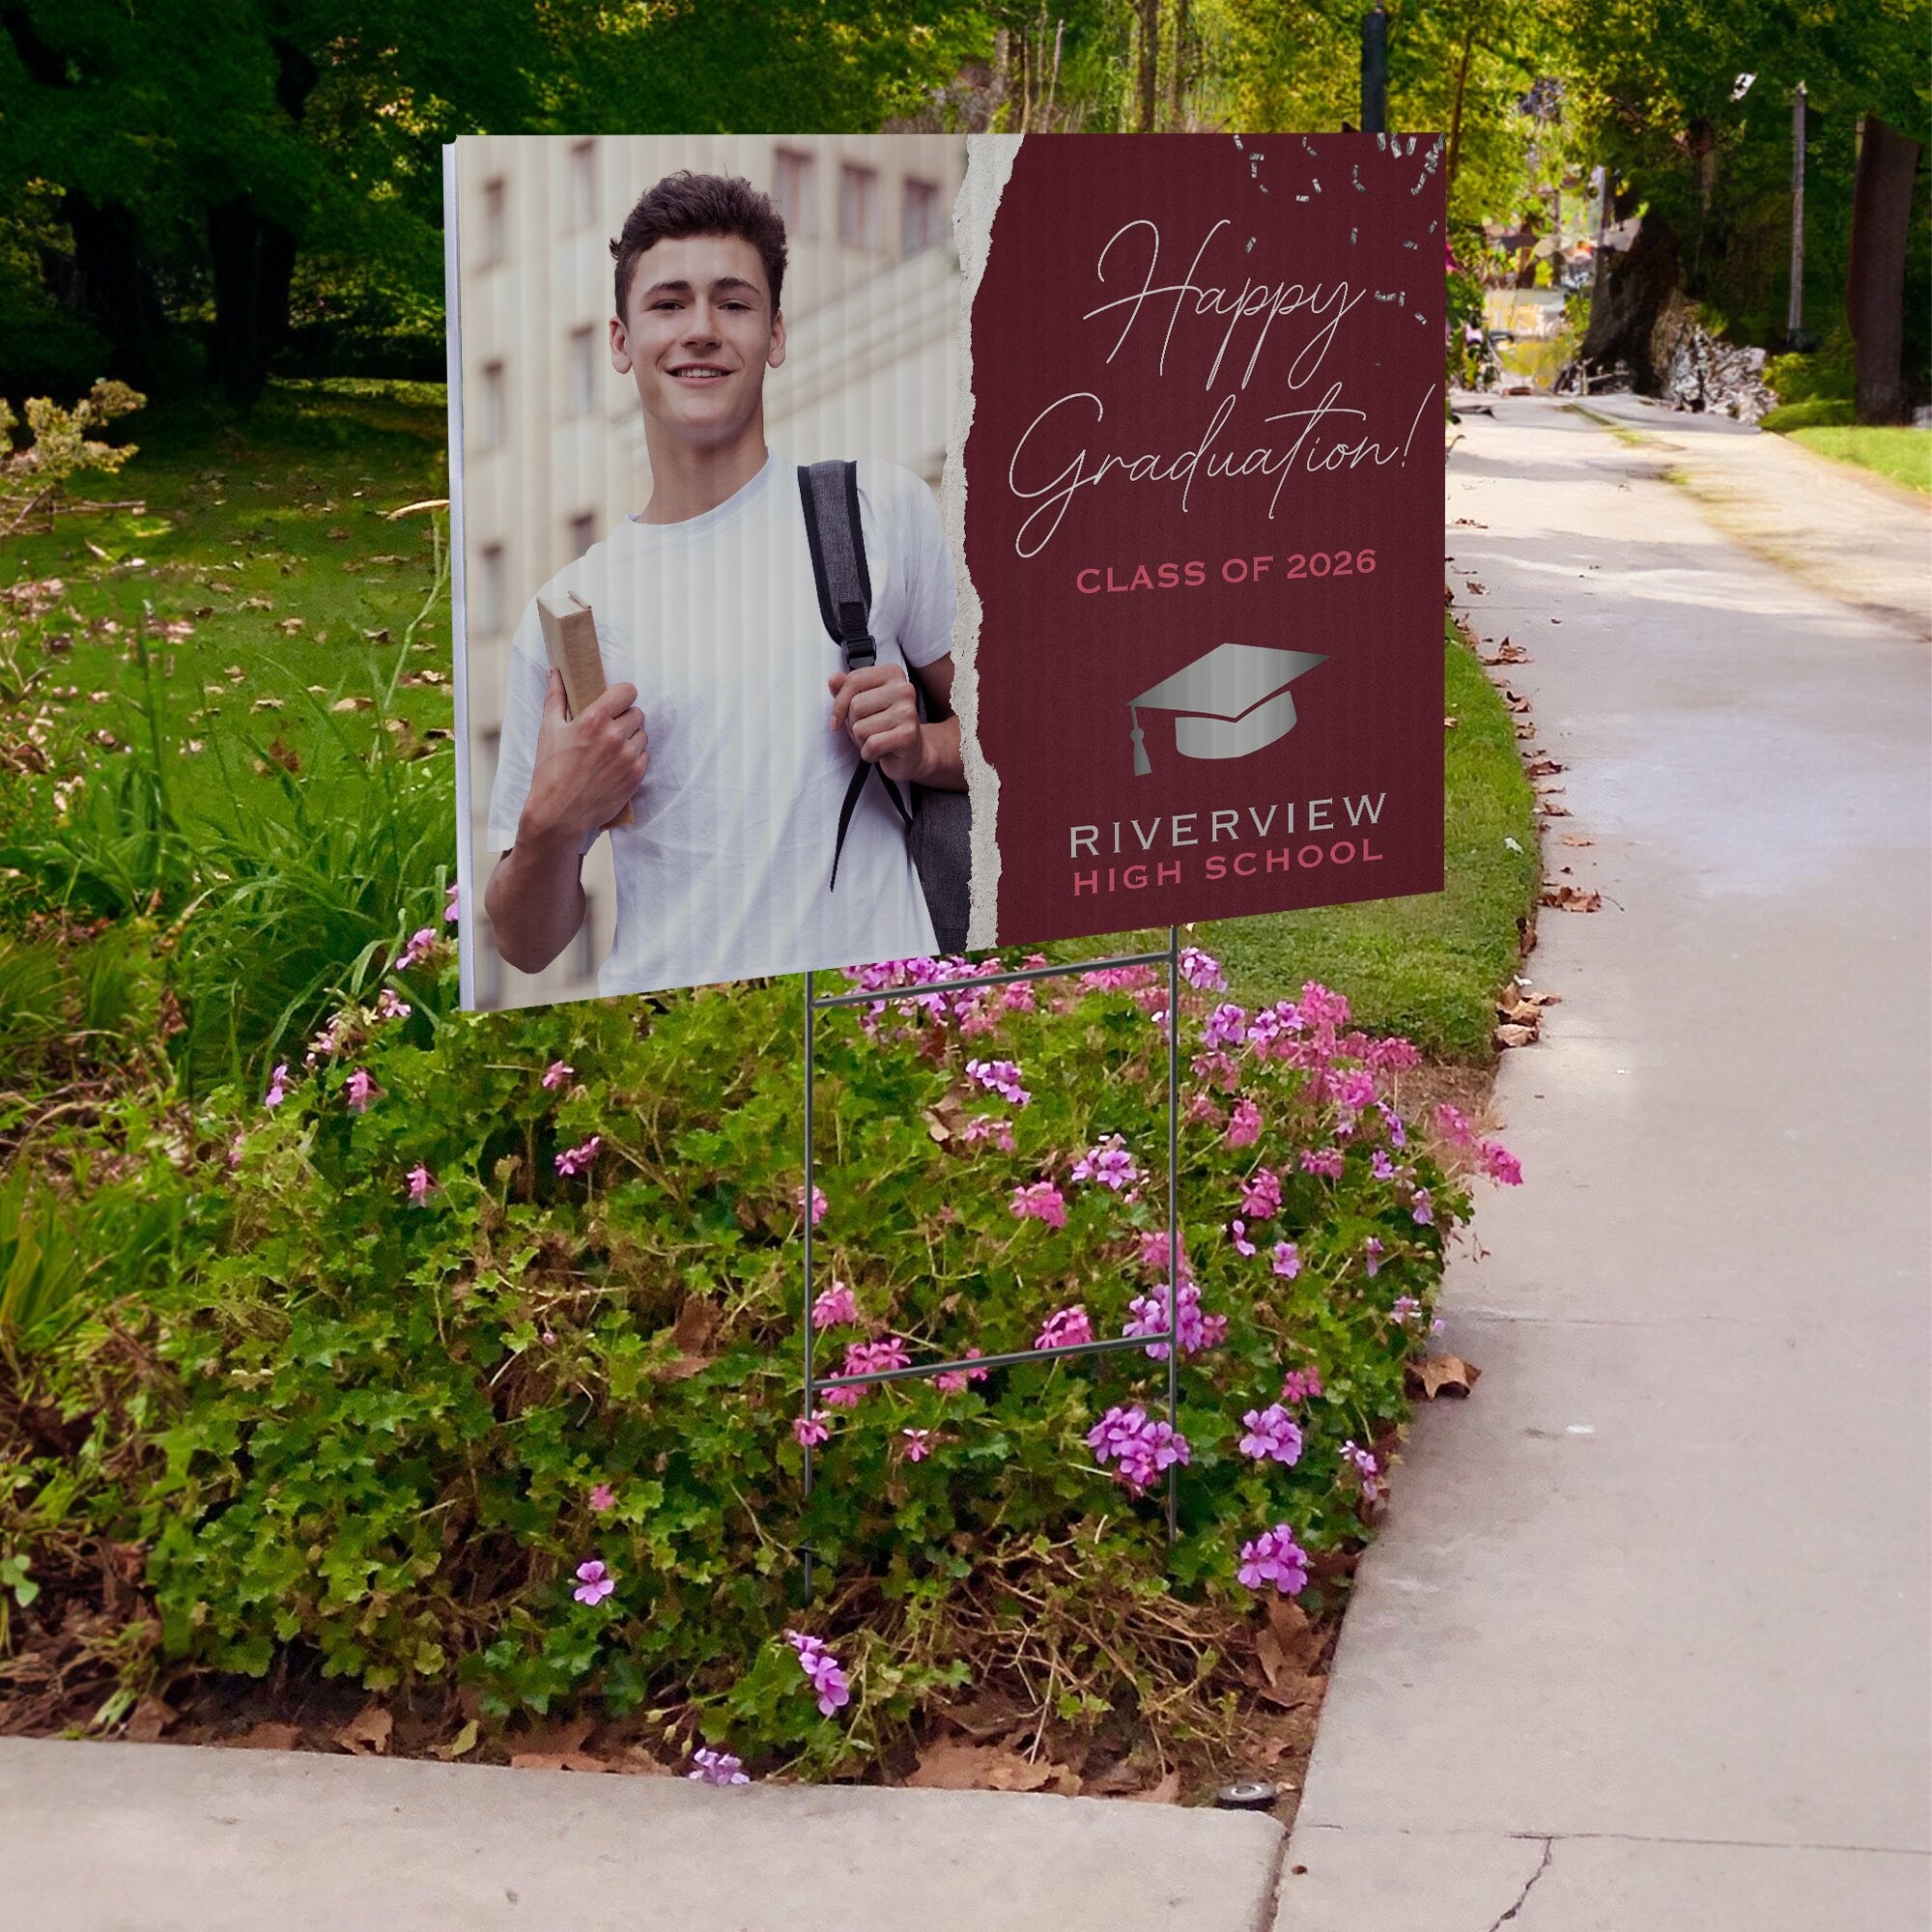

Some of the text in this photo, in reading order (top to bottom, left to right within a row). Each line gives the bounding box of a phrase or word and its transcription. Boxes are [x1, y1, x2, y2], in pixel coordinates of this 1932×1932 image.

[1083, 219, 1367, 391] Happy
[1009, 383, 1436, 558] Graduation!
[1076, 549, 1378, 594] CLASS OF 2026
[1069, 792, 1387, 859] RIVERVIEW
[1073, 838, 1383, 896] HIGH SCHOOL
